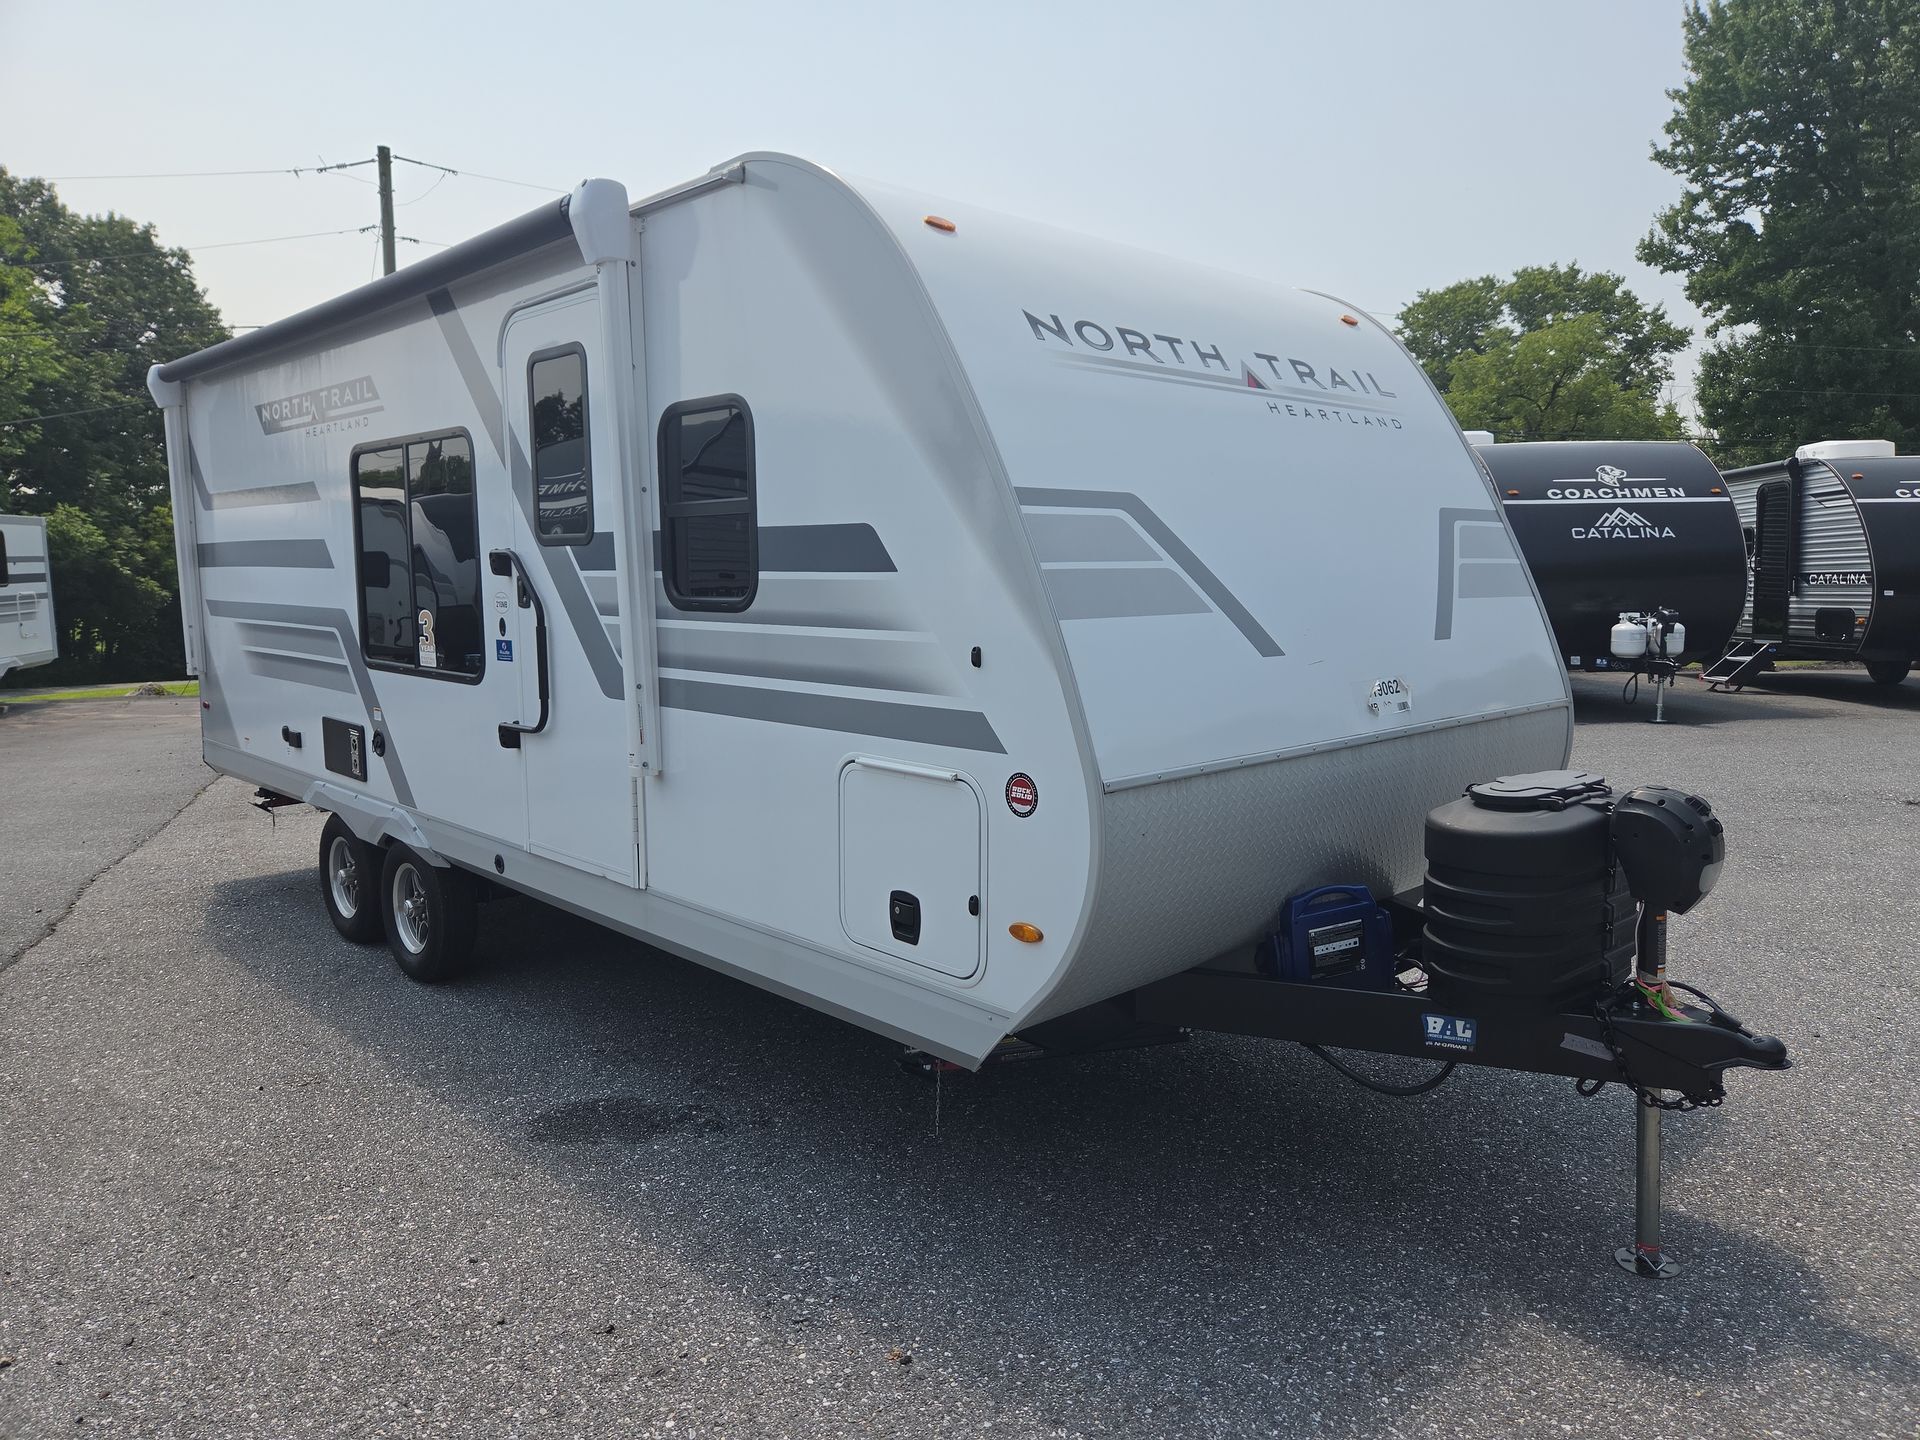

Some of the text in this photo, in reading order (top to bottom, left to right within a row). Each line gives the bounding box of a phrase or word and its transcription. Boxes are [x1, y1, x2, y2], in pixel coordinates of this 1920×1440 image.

[1021, 308, 1398, 399] NORTH TRAIL
[261, 380, 373, 422] NORTH TRAIL
[1266, 401, 1403, 430] HEARTLAND
[305, 416, 369, 438] HEARTLAND
[1546, 487, 1686, 499] COACHMEN
[1571, 526, 1676, 539] CATALINA
[1808, 573, 1868, 585] CATALINA
[1011, 792, 1033, 800] SOLID
[1012, 786, 1031, 794] ROCK
